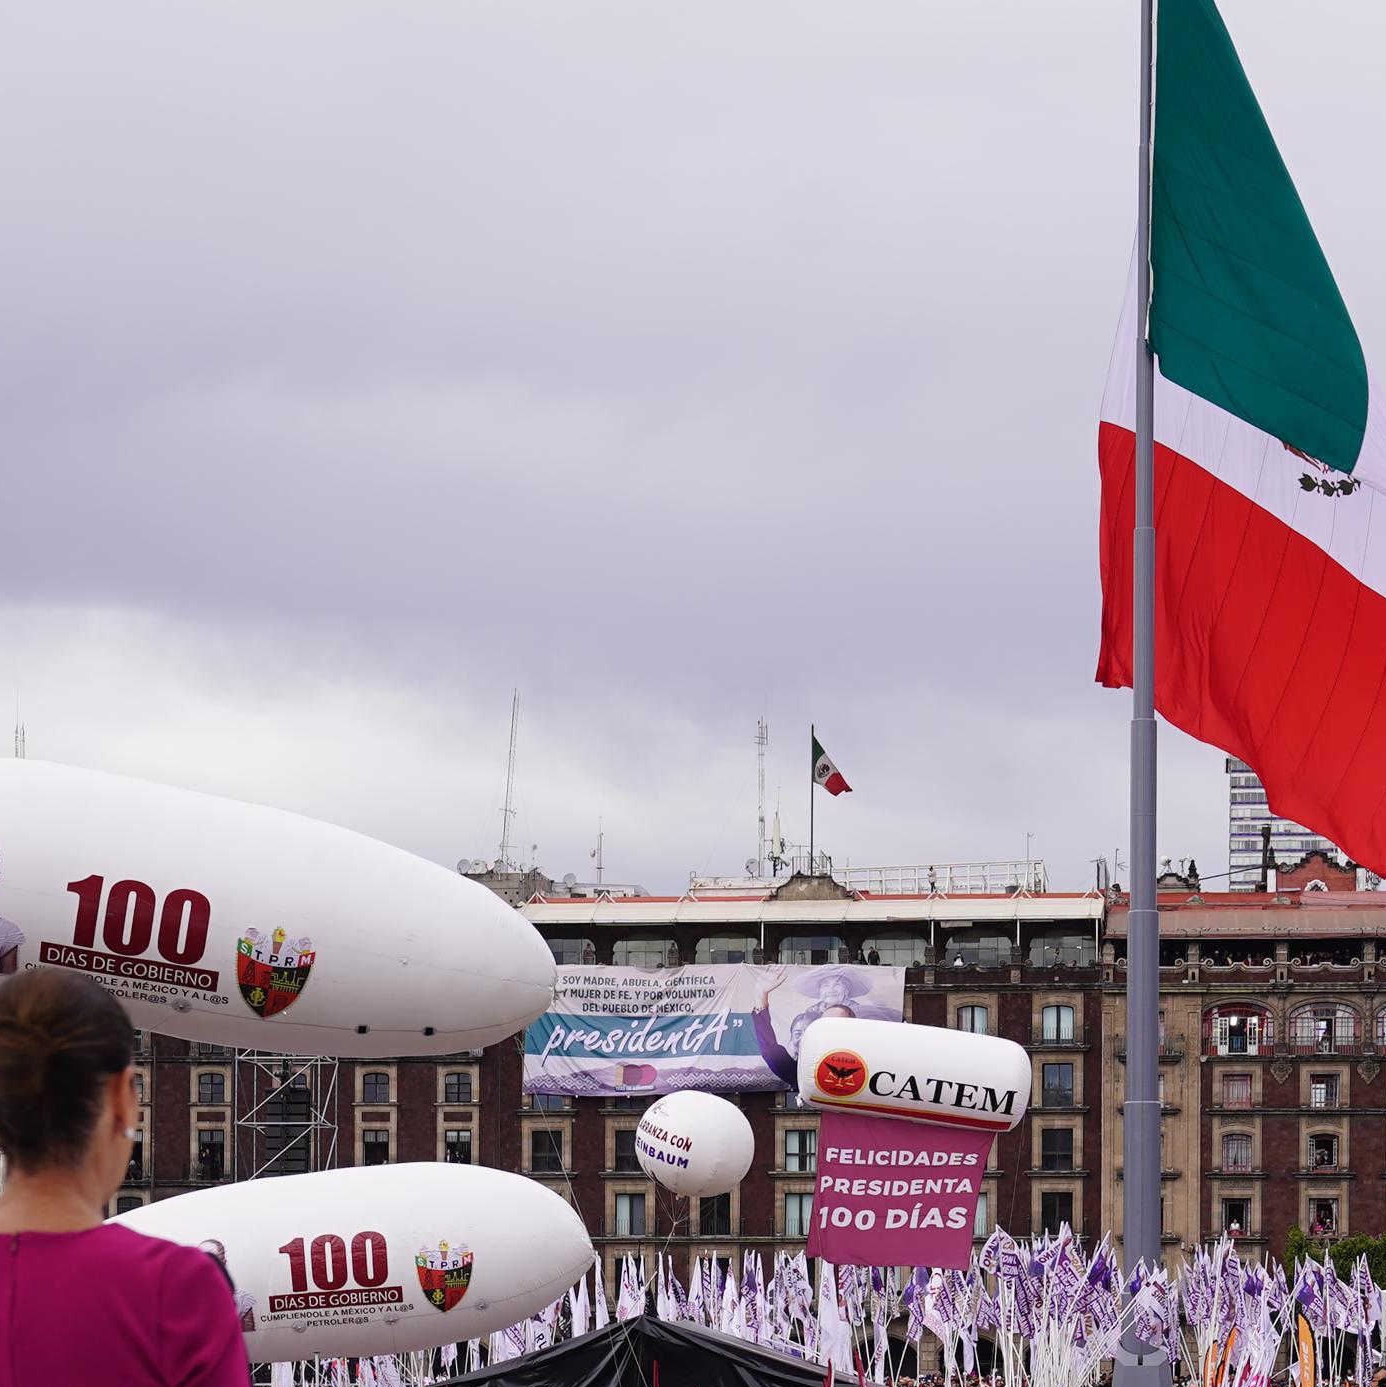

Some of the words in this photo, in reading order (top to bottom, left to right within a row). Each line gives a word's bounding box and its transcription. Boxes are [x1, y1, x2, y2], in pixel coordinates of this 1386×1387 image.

[66, 874, 212, 967] 100
[47, 946, 88, 969] DÍAS
[92, 957, 117, 973] DE
[120, 961, 213, 989] GOBIERNO
[132, 981, 179, 996] MÉXICO
[182, 988, 192, 996] Y
[191, 991, 200, 999] A
[202, 993, 229, 1005] L@S
[562, 976, 581, 986] SOY
[583, 976, 619, 988] MADRE,
[622, 978, 662, 989] ABUELA,
[665, 975, 716, 988] CIENTÍFICA
[562, 989, 569, 999] Y
[570, 989, 602, 1000] MUJER
[603, 990, 616, 1000] DE
[635, 991, 642, 1000] Y
[643, 990, 663, 1000] POR
[665, 989, 716, 1000] VOLUNTAD
[582, 1002, 601, 1013] DEL
[602, 1003, 640, 1014] PUEBLO
[641, 1004, 654, 1013] DE
[868, 1071, 1018, 1116] CATEM
[635, 1136, 690, 1170] EINBAUM
[670, 1134, 693, 1153] CON
[825, 1147, 979, 1167] FELICIDADES
[820, 1175, 973, 1197] PRESIDENTA
[819, 1205, 876, 1231] 100
[884, 1202, 968, 1230] DÍAS
[278, 1230, 389, 1293] 100
[274, 1294, 307, 1312] DÍAS
[308, 1293, 328, 1308] DE
[329, 1288, 399, 1308] GOBIERNO
[260, 1309, 331, 1323] CUMPLIENDOLE
[332, 1309, 341, 1317] A
[341, 1305, 377, 1317] MÉXICO
[376, 1306, 385, 1314] Y
[394, 1303, 415, 1313] L@S
[306, 1316, 370, 1328] PETROLER@S
